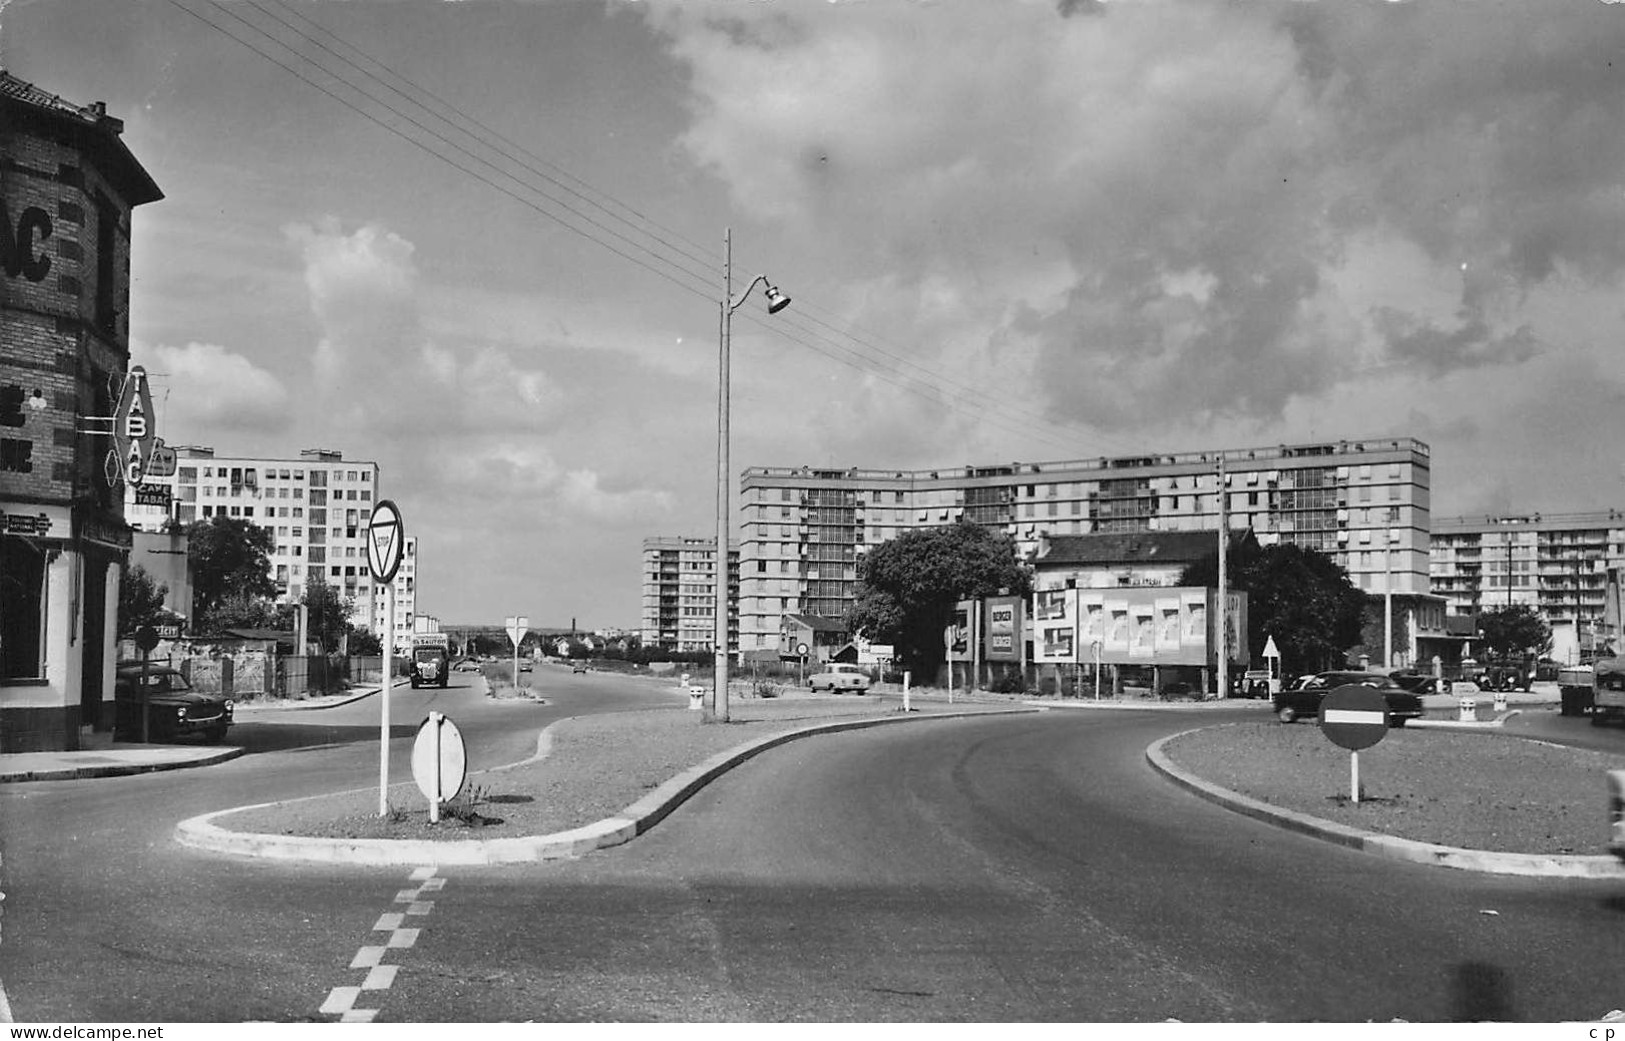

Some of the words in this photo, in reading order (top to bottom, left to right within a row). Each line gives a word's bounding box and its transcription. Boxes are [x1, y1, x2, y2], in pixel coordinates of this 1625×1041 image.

[125, 371, 147, 483] TABAC
[138, 494, 170, 505] TABAC
[378, 536, 389, 547] STOP
